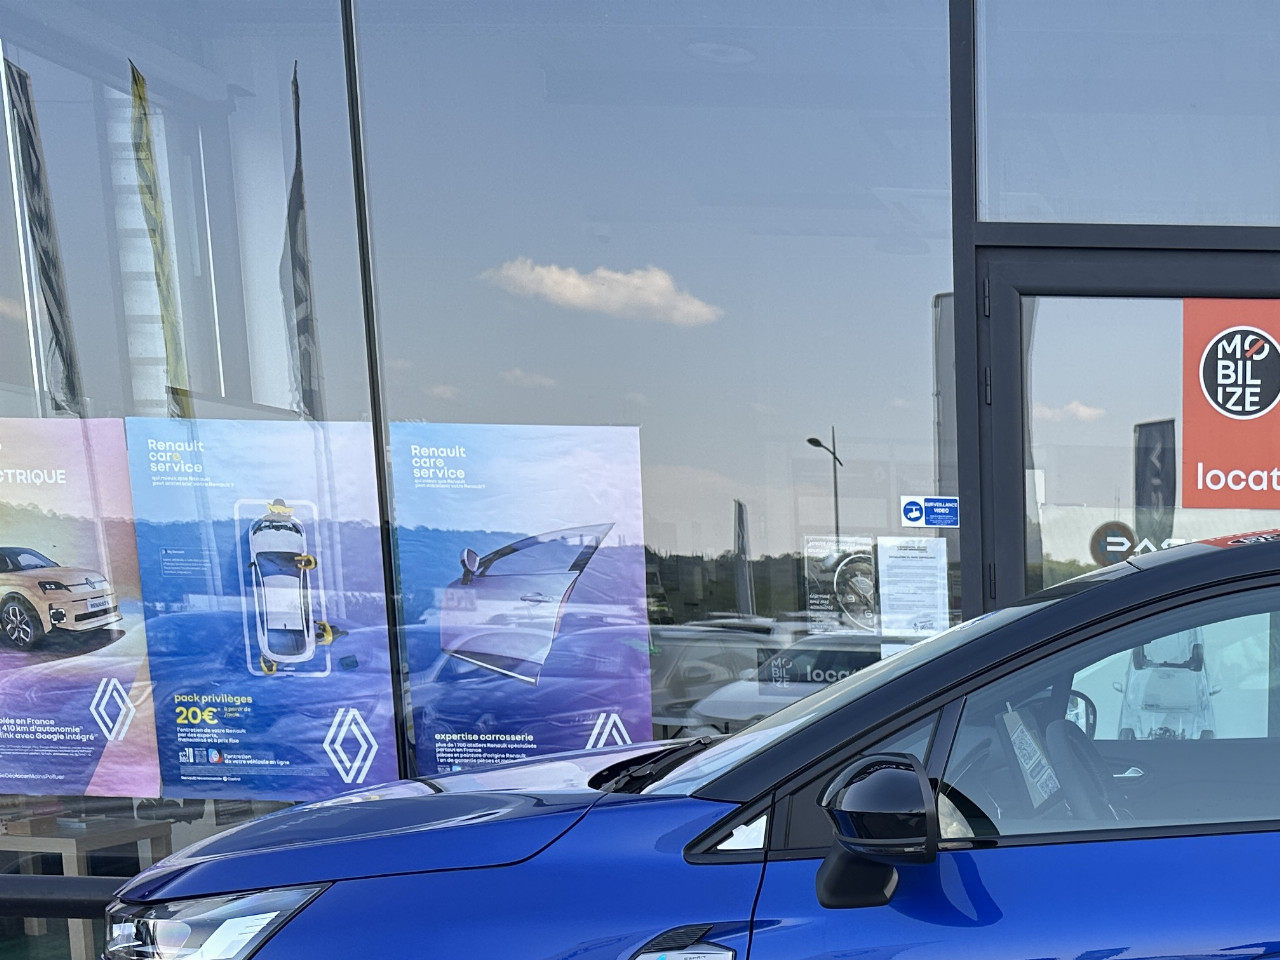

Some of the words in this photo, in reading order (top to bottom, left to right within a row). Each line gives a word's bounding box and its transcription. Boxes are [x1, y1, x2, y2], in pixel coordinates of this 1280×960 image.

[1217, 360, 1261, 385] BIL
[1217, 386, 1261, 411] IZE
[148, 439, 204, 452] Renault
[411, 445, 466, 457] Renault
[149, 451, 181, 461] care
[150, 461, 203, 472] service
[412, 458, 444, 467] care
[413, 466, 465, 478] service
[772, 668, 790, 678] BIL
[807, 665, 863, 681] loca
[175, 693, 200, 704] pack
[202, 694, 253, 705] privilèges
[27, 718, 55, 726] France
[36, 733, 65, 741] Google
[435, 732, 479, 742] expertise
[480, 732, 534, 741] carrosserie
